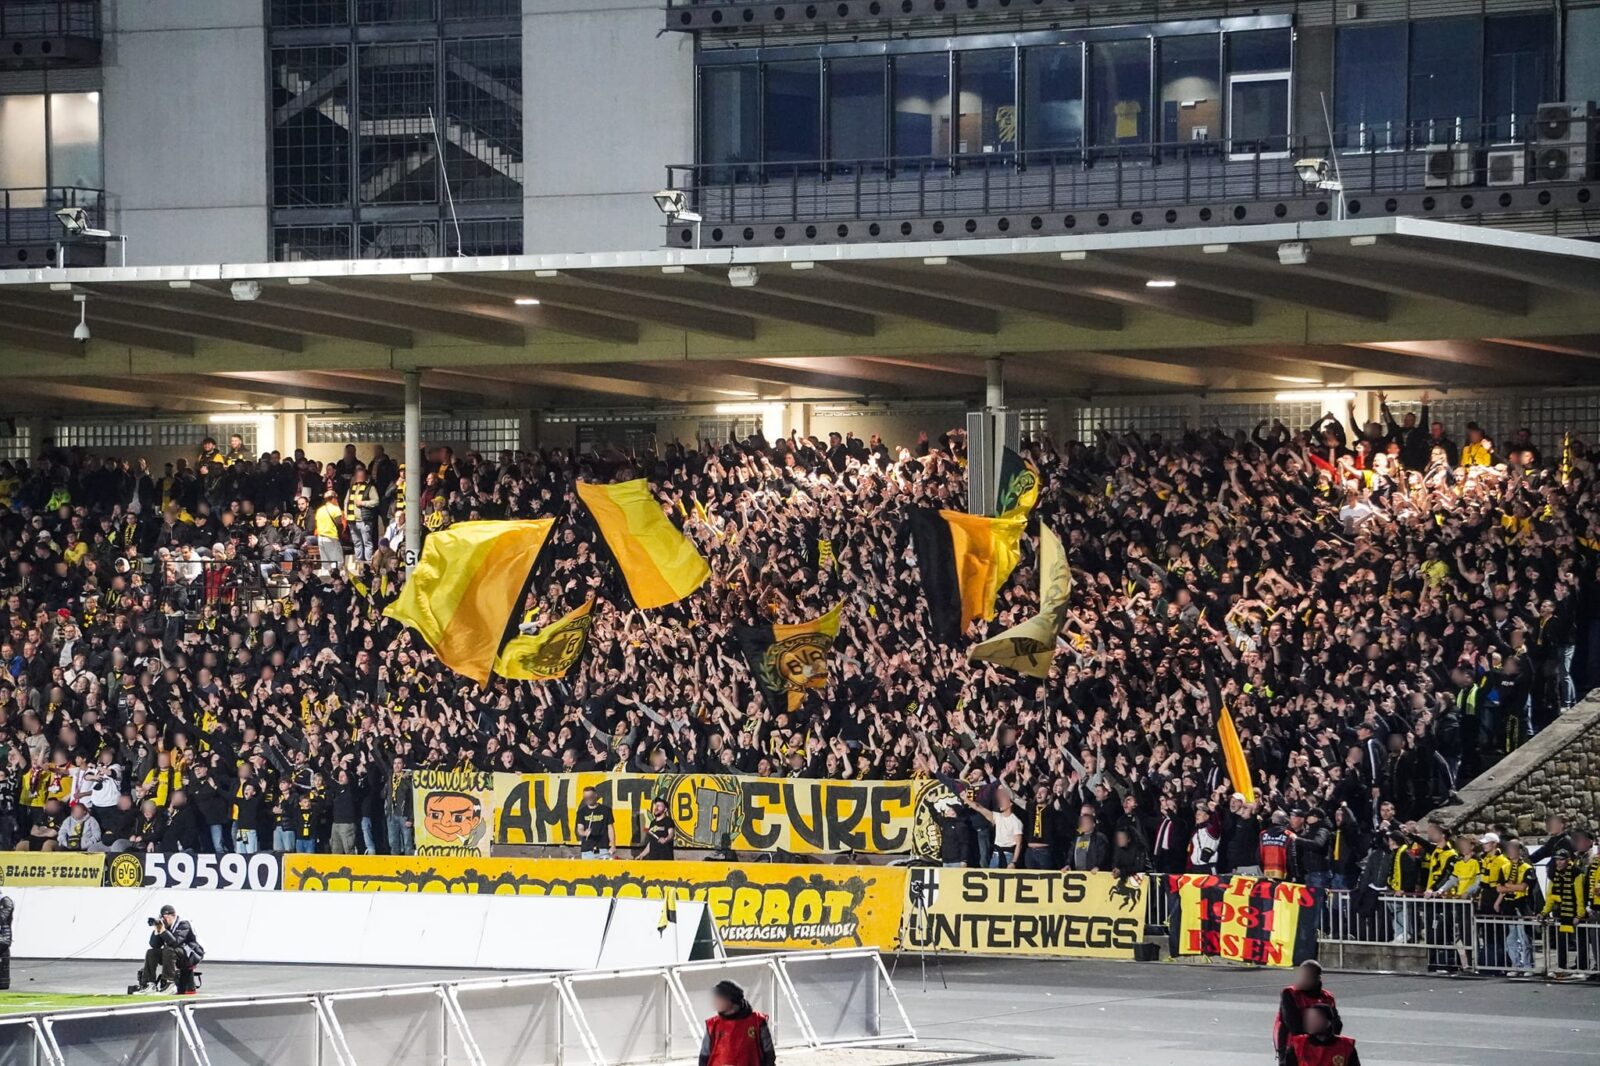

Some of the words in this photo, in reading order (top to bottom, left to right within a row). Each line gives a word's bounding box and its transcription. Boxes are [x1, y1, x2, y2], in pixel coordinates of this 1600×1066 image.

[405, 550, 420, 565] G
[413, 771, 485, 791] SCONVOLTS
[6, 865, 99, 879] BLACK-YELLOW
[118, 863, 135, 880] BVB
[144, 853, 278, 890] 59590
[962, 871, 1087, 904] STETS
[1196, 898, 1275, 931] 1981
[720, 923, 787, 940] VERZAGEN
[794, 922, 856, 938] FREUNDE!
[909, 913, 1138, 949] UNTERWEGS
[1187, 929, 1283, 964] ESSEN
